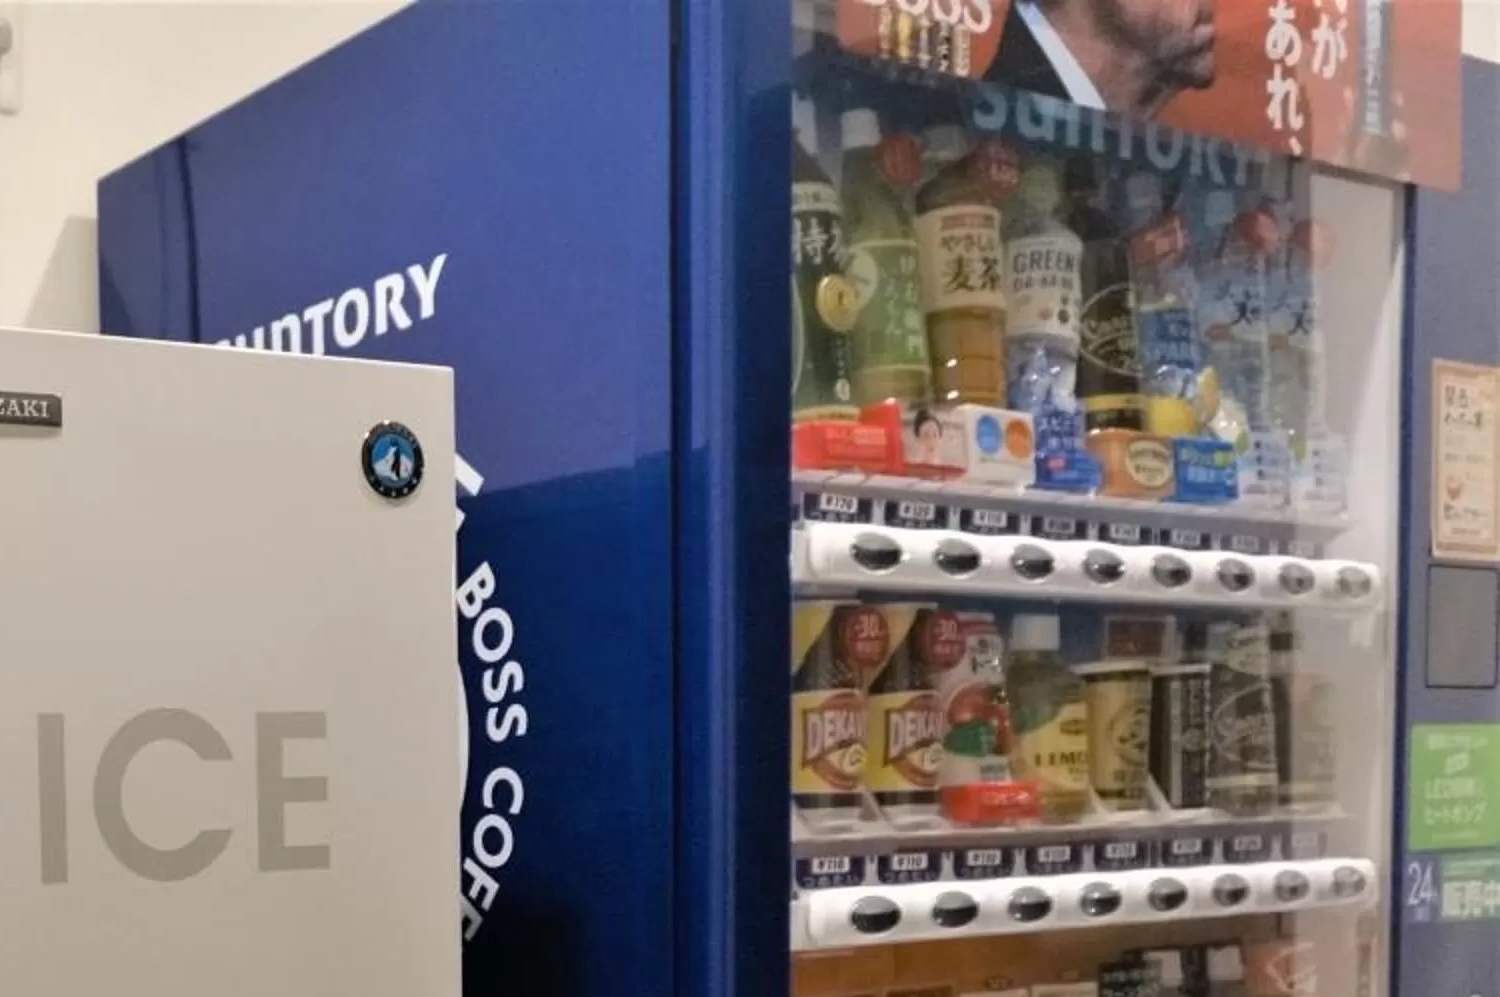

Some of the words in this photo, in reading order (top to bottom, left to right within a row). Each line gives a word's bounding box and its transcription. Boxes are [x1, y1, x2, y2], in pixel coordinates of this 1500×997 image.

[1311, 0, 1348, 79] が
[214, 252, 448, 356] NTORY
[1012, 249, 1075, 273] GREEN
[457, 561, 529, 743] BOSS
[37, 707, 331, 885] ICE
